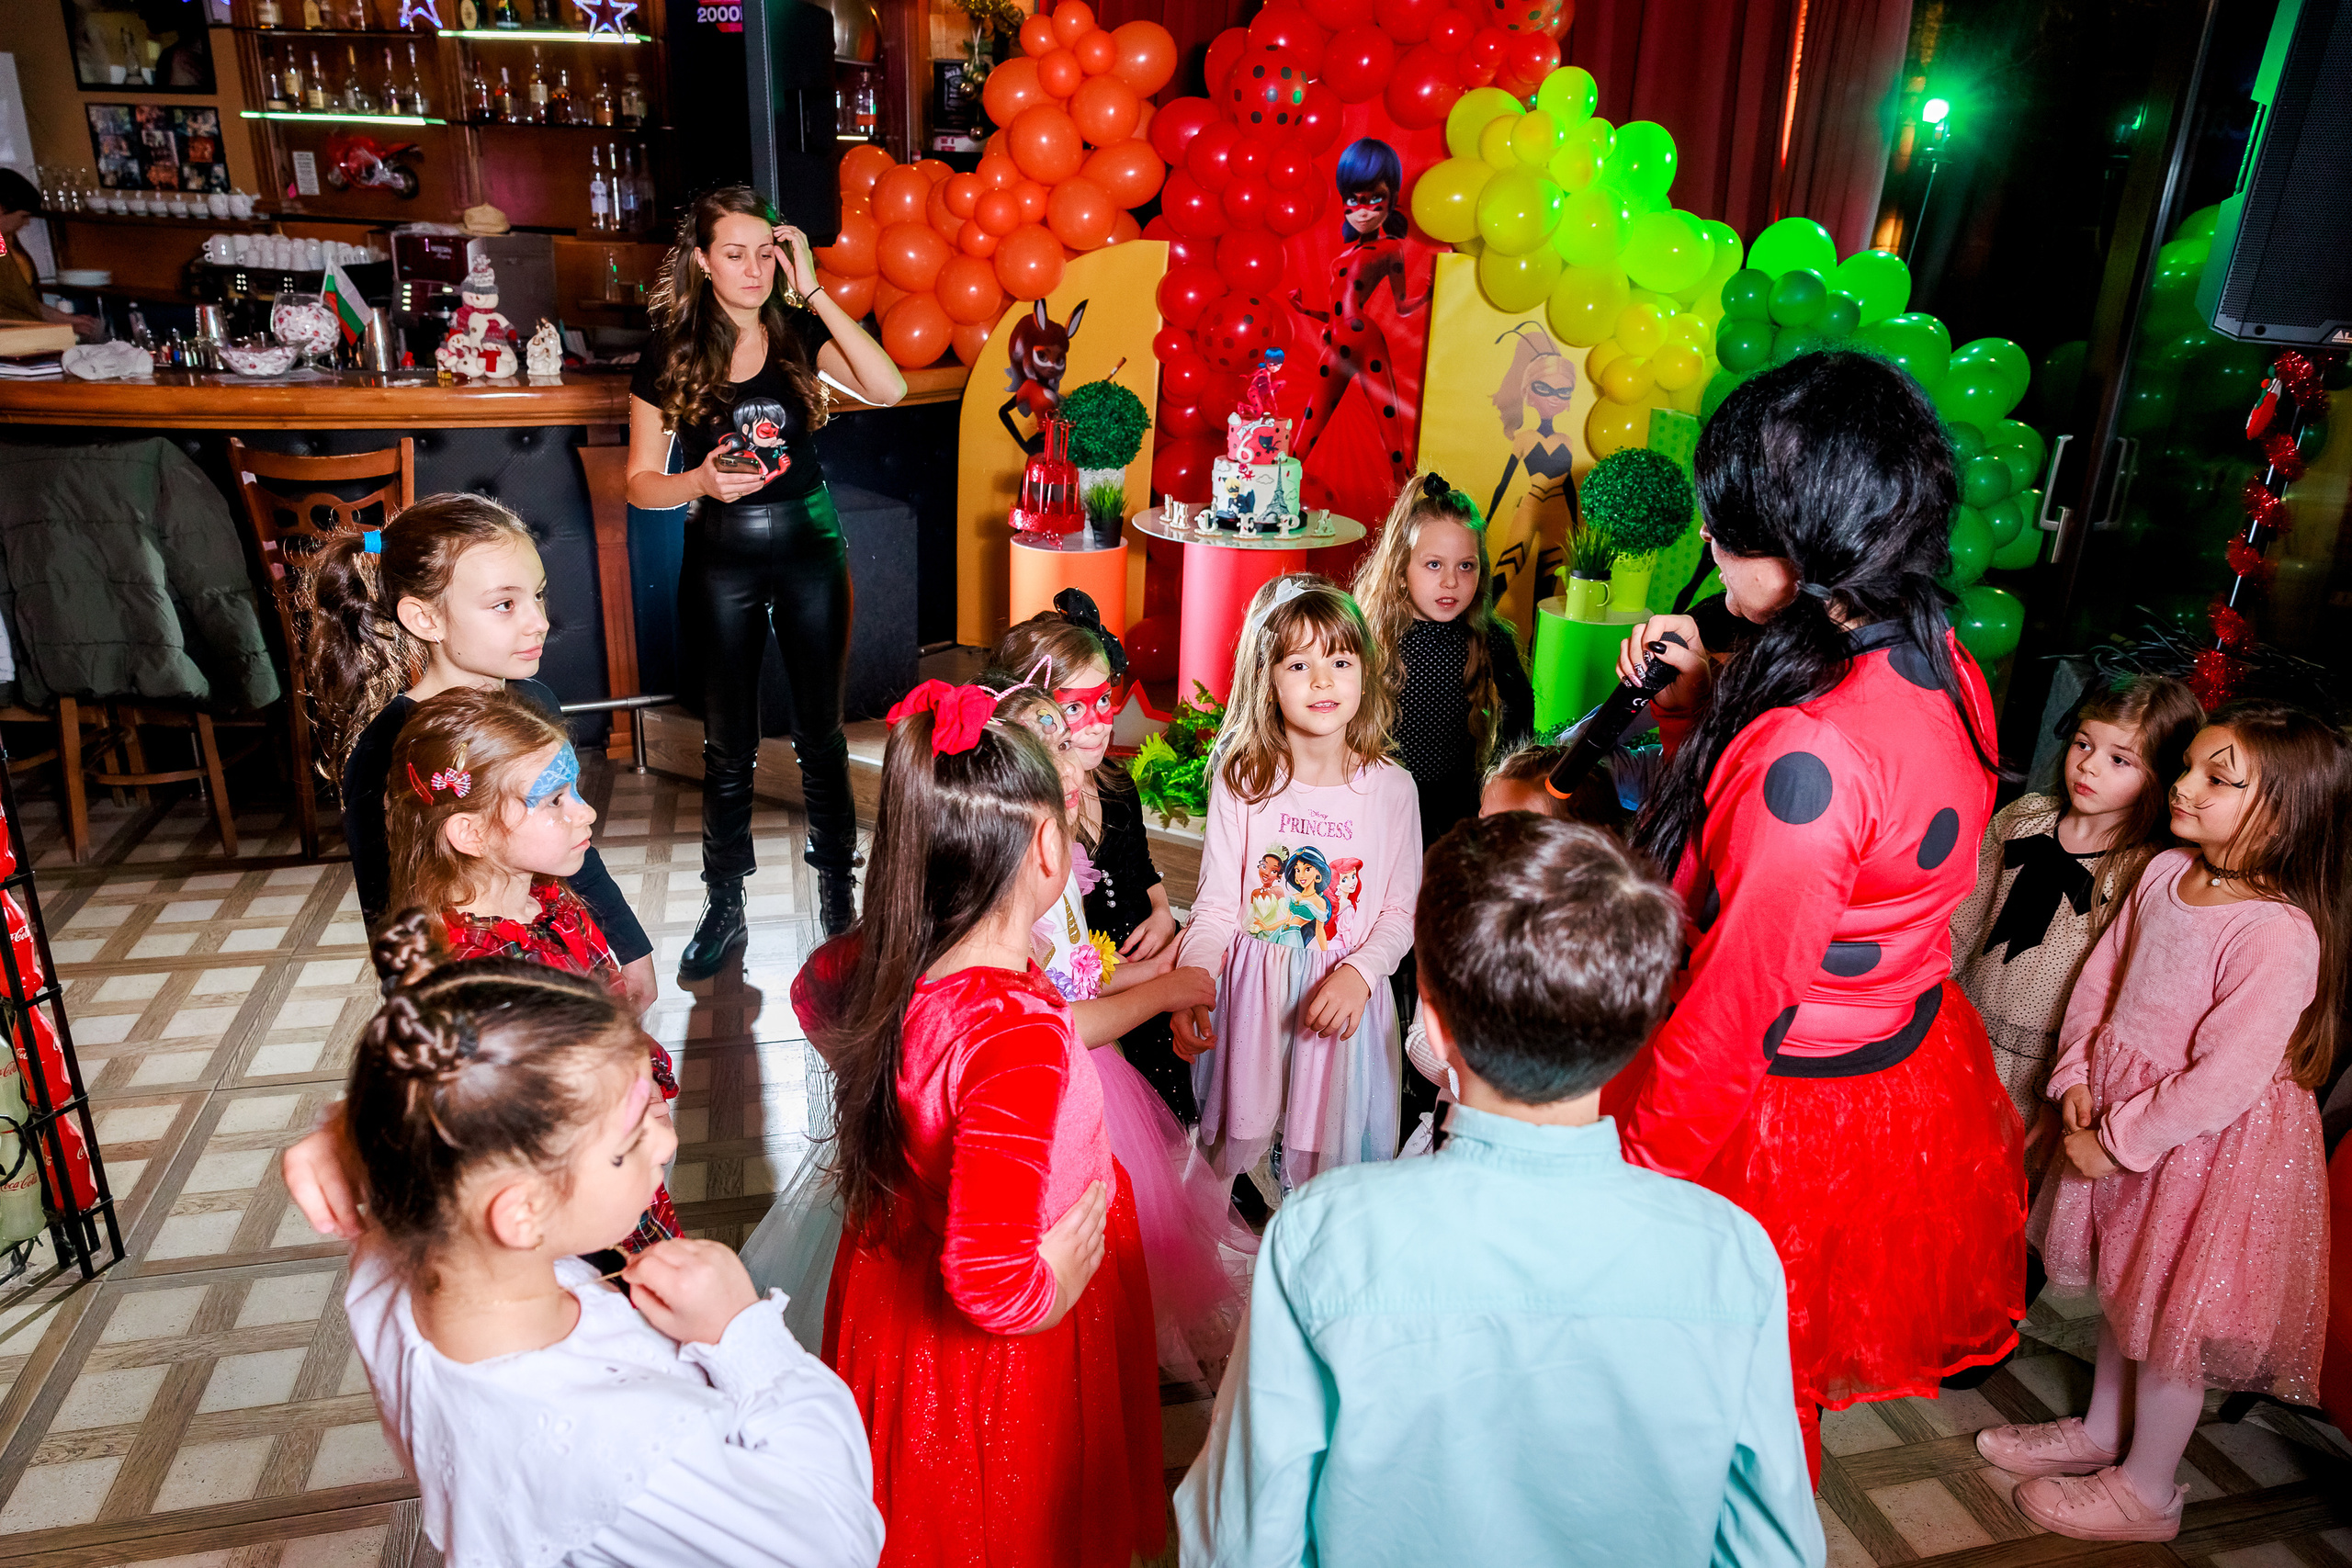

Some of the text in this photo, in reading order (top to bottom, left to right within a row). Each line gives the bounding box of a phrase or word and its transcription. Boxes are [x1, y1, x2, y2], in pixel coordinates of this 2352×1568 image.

[696, 6, 742, 23] 2000
[1237, 434, 1254, 463] 6
[1278, 812, 1353, 841] PRINCESS
